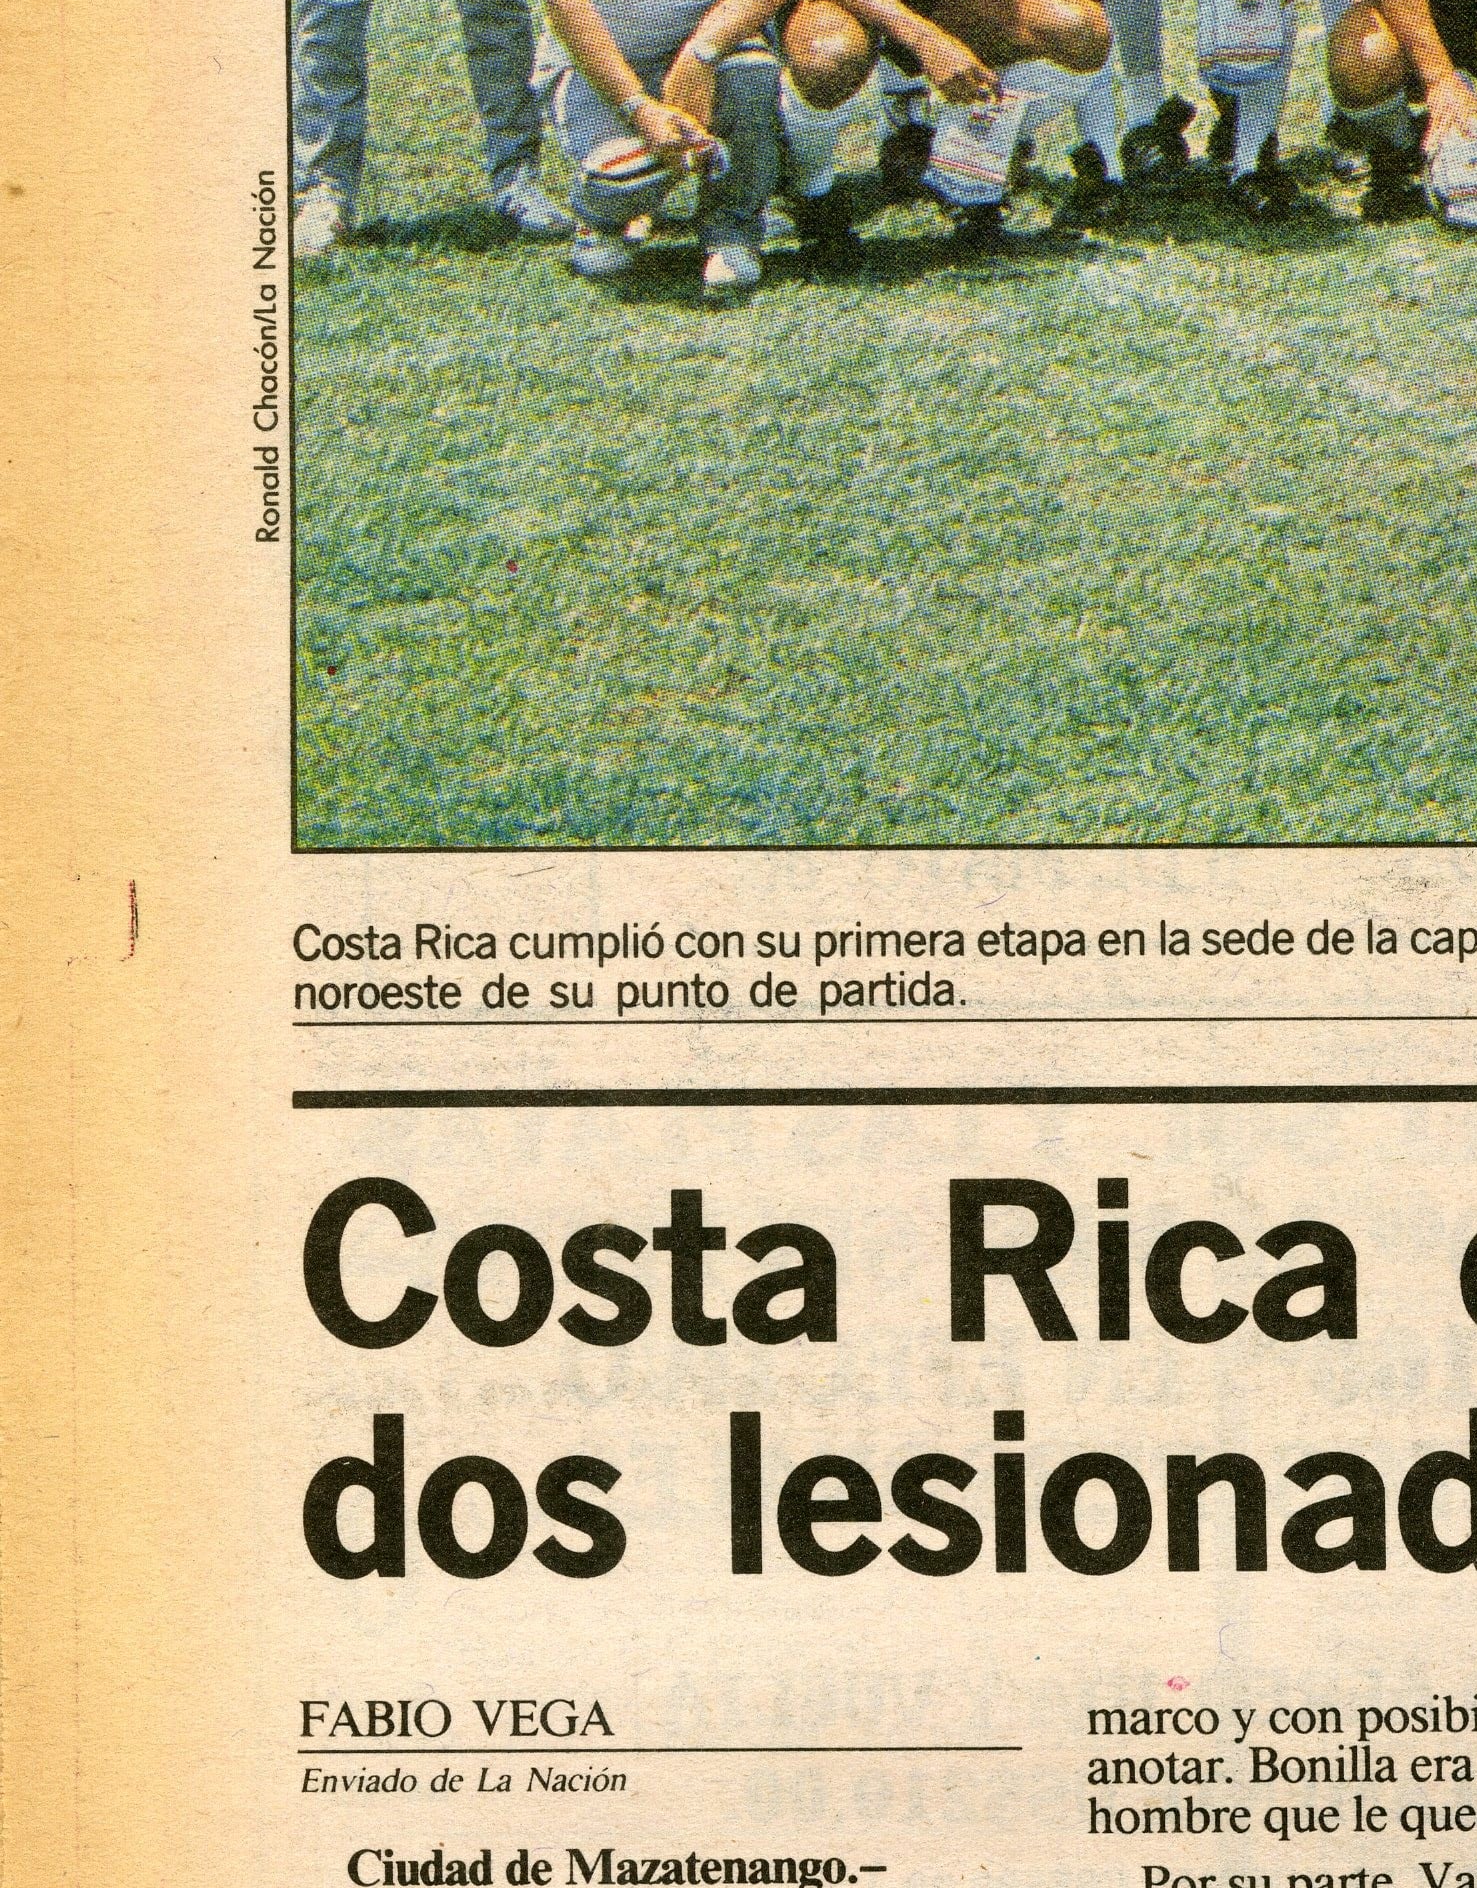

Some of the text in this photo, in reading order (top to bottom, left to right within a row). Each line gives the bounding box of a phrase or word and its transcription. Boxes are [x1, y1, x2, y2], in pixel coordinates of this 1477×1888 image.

[251, 171, 280, 542] Ronald Chacón/La Nación
[294, 924, 401, 961] Costa
[416, 924, 496, 959] Rica
[510, 922, 664, 967] cumplió
[676, 932, 743, 958] con
[757, 932, 799, 958] su
[816, 922, 964, 966] primera
[978, 922, 1085, 965] etapa
[1099, 930, 1144, 956] en
[1161, 920, 1189, 955] la
[1203, 920, 1294, 955] sede
[1307, 920, 1354, 955] de
[1368, 919, 1397, 954] la
[303, 1177, 837, 1349] Costa
[950, 1178, 1357, 1343] Rica
[303, 1414, 626, 1579] dos
[300, 1699, 614, 1737] FABIO VEGA
[302, 1768, 626, 1792] Enviado de La Nación
[348, 1849, 493, 1886] Ciudad
[506, 1849, 552, 1886] de
